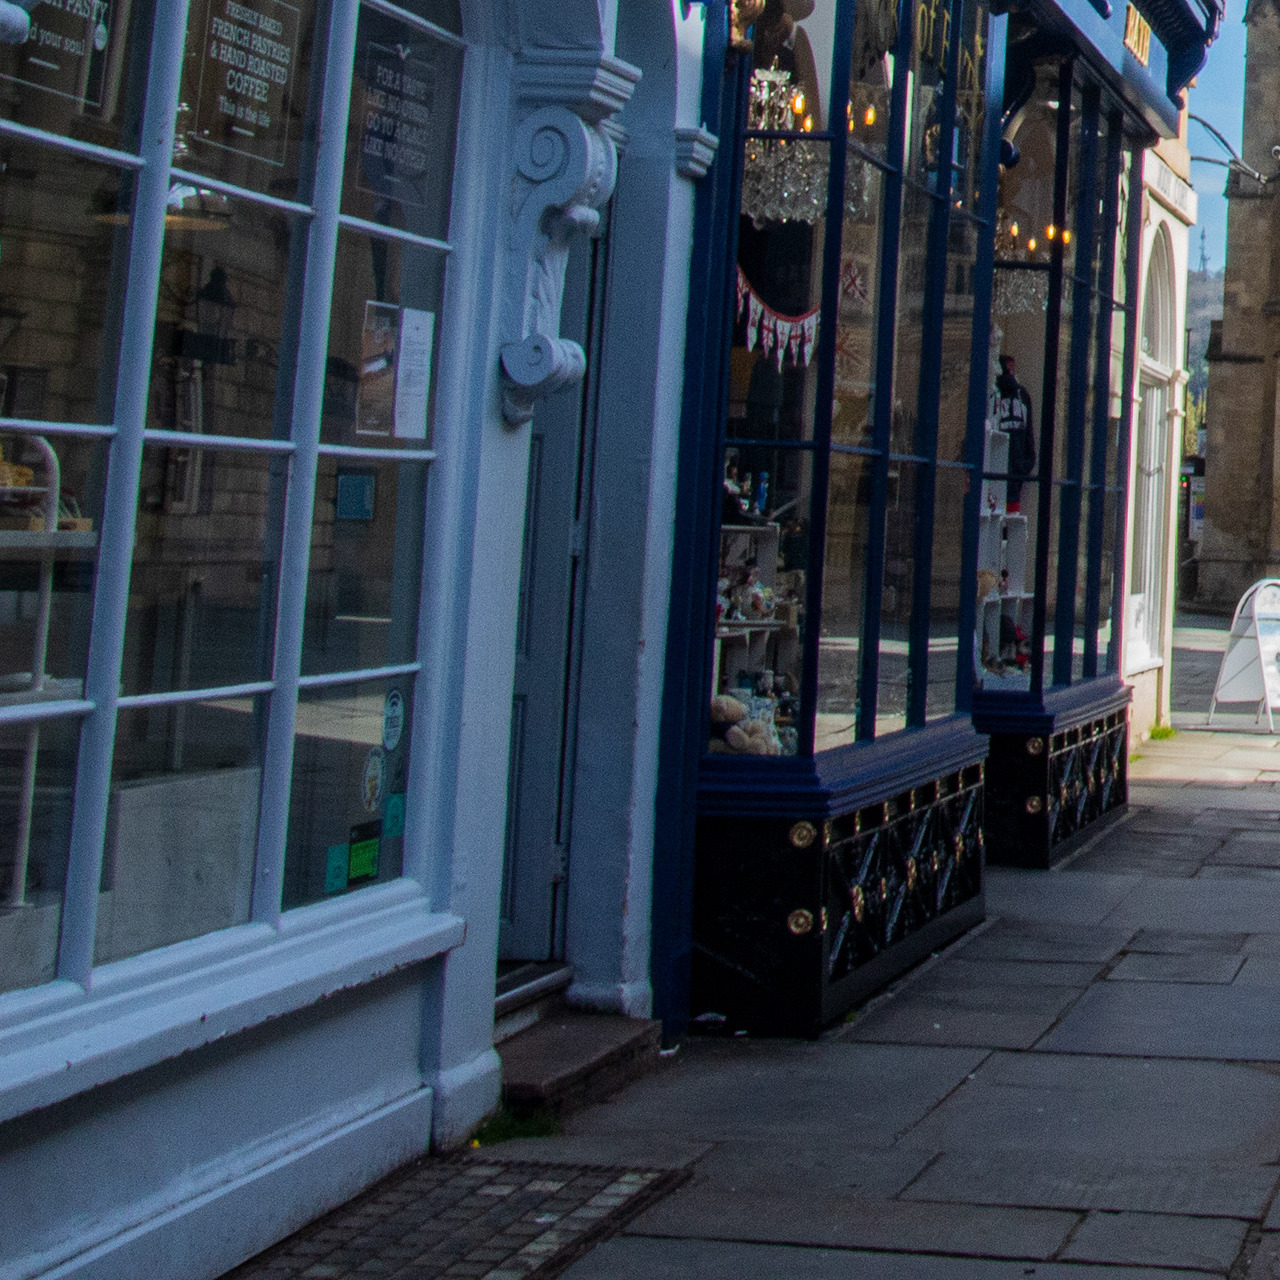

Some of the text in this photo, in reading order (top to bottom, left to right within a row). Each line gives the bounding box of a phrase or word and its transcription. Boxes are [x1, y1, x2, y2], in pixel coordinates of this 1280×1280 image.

[225, 0, 259, 26] FRESHLY
[39, 28, 63, 48] your
[63, 38, 86, 56] soul
[211, 17, 291, 65] FRENCH PASTRIES
[210, 39, 289, 85] & HAND ROASTED
[226, 69, 270, 103] COFFEE
[218, 94, 236, 116] This
[236, 101, 244, 119] is
[244, 105, 258, 124] the
[366, 111, 380, 132] GO
